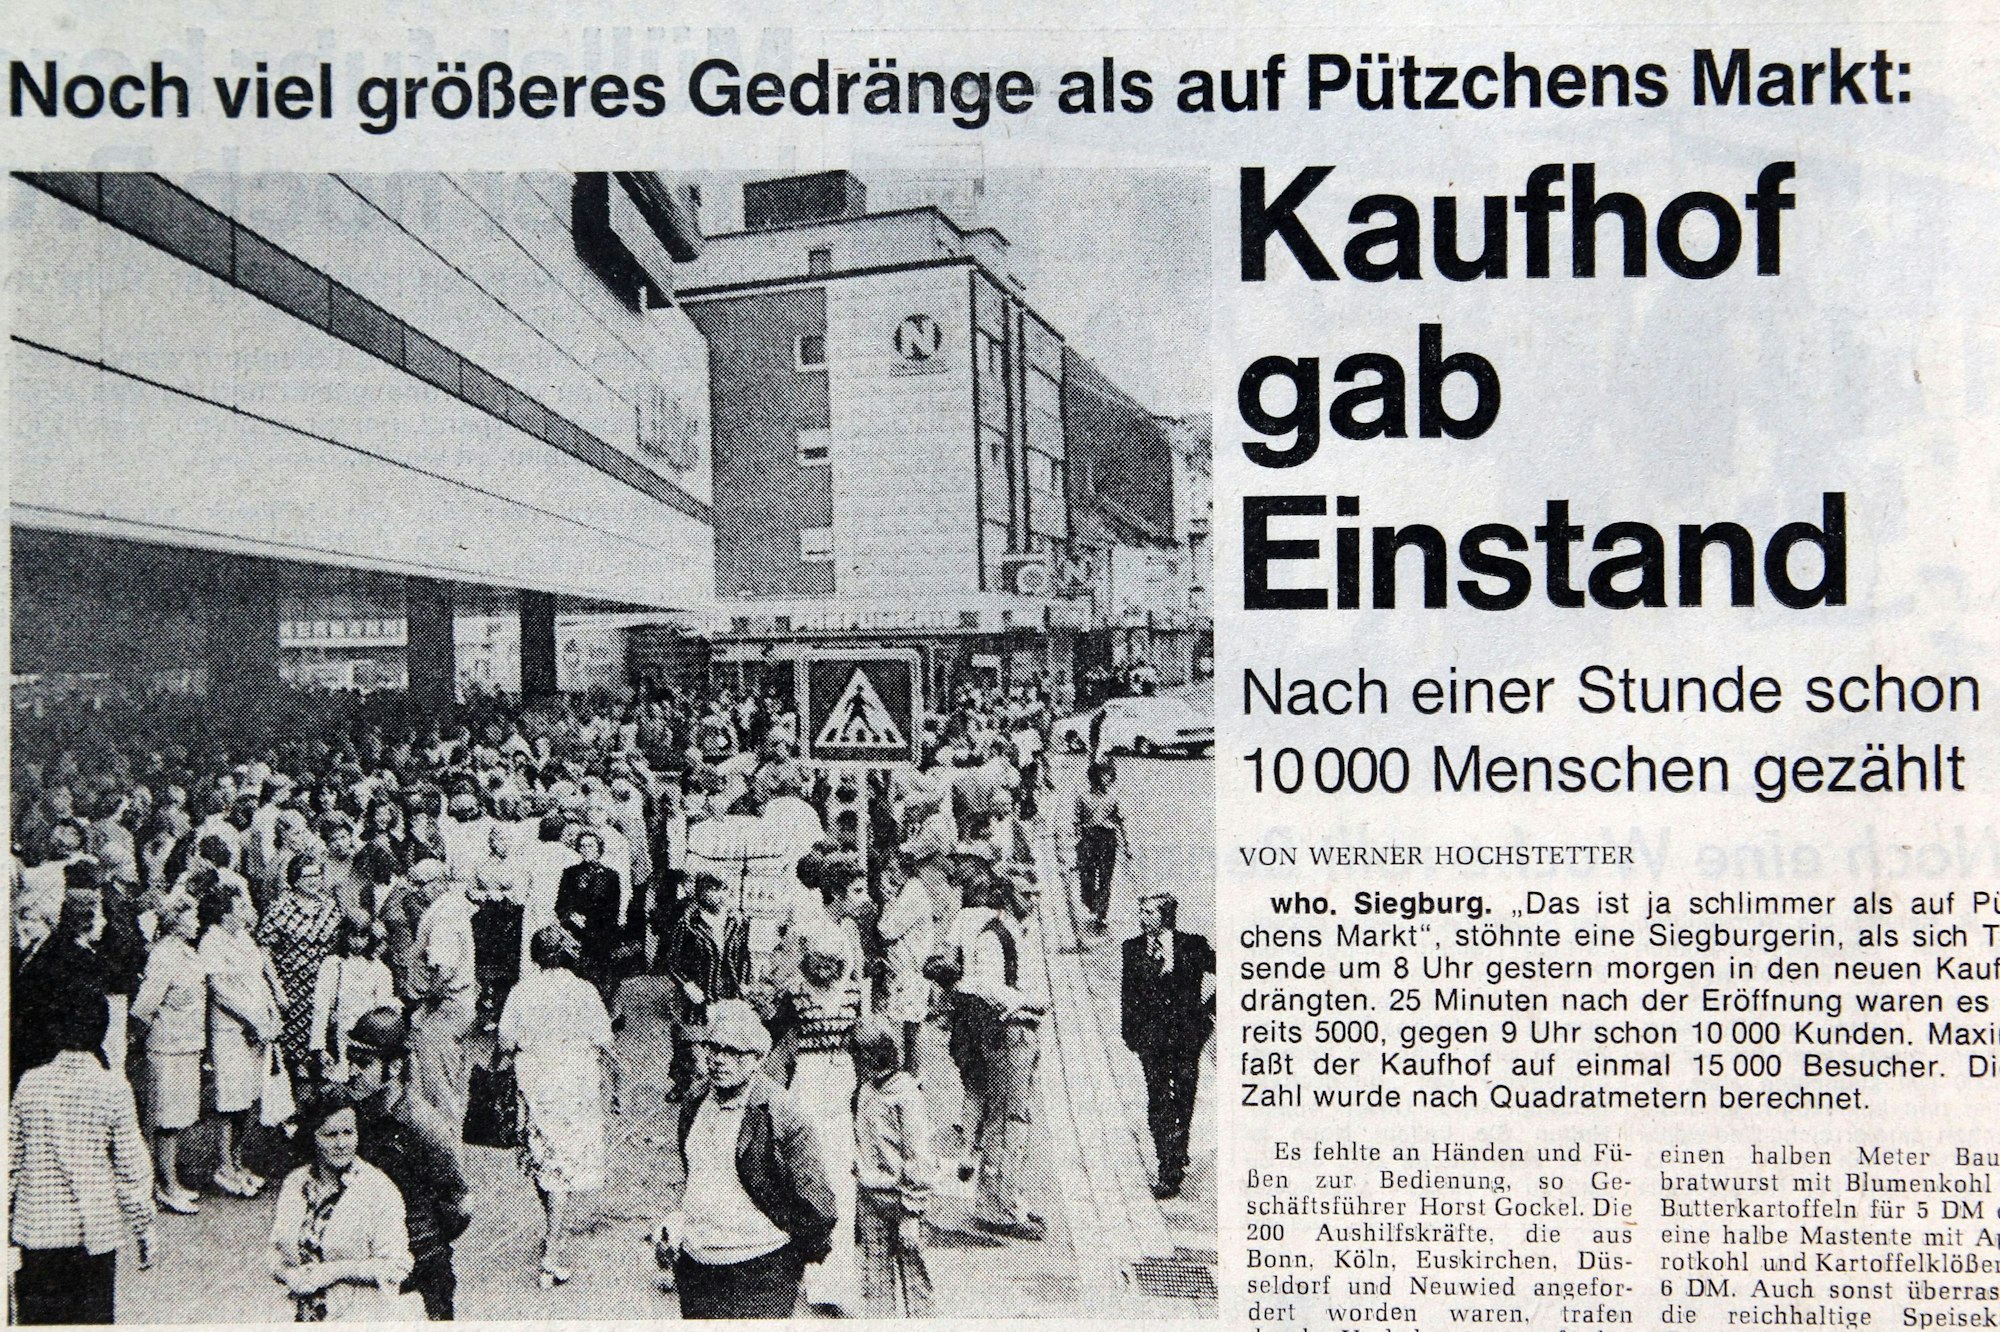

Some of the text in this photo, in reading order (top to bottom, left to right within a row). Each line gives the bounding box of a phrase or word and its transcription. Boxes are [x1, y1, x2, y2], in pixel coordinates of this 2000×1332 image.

[9, 47, 1911, 135] Noch viel größeres Gedränge als auf Pützchens Markt:
[1239, 160, 1796, 283] Kaufhof
[1237, 322, 1502, 470] gab
[1242, 491, 1847, 612] Einstand
[1243, 664, 1979, 716] Nach einer Stunde schon
[1434, 744, 1729, 794] Menschen
[1754, 743, 1966, 804] gezählt
[1239, 845, 1635, 867] VON WERNER HOCHSTETTER
[1269, 891, 1337, 916] who.
[1354, 891, 1492, 920] Siegburg.
[1512, 891, 1580, 918] „Das
[1598, 891, 1629, 915] ist
[1645, 890, 1672, 920] ja
[1689, 891, 1836, 915] schlimmer
[1853, 891, 1893, 915] als
[1911, 891, 1955, 915] auf
[1240, 924, 1322, 949] chens
[1337, 923, 1440, 950] Markt“,
[1455, 923, 1561, 947] stöhnte
[1574, 923, 1635, 947] eine
[1649, 922, 1843, 953] Siegburgerin,
[1858, 923, 1899, 948] als
[1912, 923, 1967, 948] sich
[1240, 956, 1326, 981] sende
[1339, 961, 1380, 980] um
[1393, 956, 1409, 980] 8
[1423, 955, 1474, 980] Uhr
[1486, 957, 1592, 985] gestern
[1607, 961, 1715, 985] morgen
[1730, 955, 1753, 980] in
[1767, 956, 1819, 980] den
[1834, 961, 1921, 980] neuen
[1240, 987, 1989, 1018] drängten. 25 Minuten nach der Eröffnung waren es
[1242, 1019, 1303, 1044] reits
[1315, 1020, 1386, 1047] 5000,
[1400, 1025, 1488, 1050] gegen
[1501, 1020, 1517, 1044] 9
[1531, 1020, 1582, 1044] Uhr
[1594, 1020, 1677, 1045] schon
[1795, 1021, 1913, 1046] Kunden.
[1241, 1051, 1294, 1076] faßt
[1313, 1052, 1361, 1076] der
[1381, 1052, 1492, 1076] Kaufhof
[1511, 1052, 1556, 1077] auf
[1576, 1052, 1670, 1077] einmal
[1804, 1053, 1945, 1079] Besucher.
[1241, 1083, 1869, 1111] Zahl wurde nach Quadratmetern berechnet.
[1274, 1140, 1632, 1163] Es fehlte an Händen und Fü-
[1660, 1144, 1725, 1165] einen
[1750, 1144, 1831, 1166] halben
[1856, 1146, 1931, 1166] Meter
[1247, 1168, 1632, 1194] ßen zur Bedienung, so Ge-
[1660, 1170, 1992, 1194] bratwurst mit Blumenkohl
[1246, 1194, 1632, 1217] schäftsführer Horst Gockel. Die
[1660, 1197, 1857, 1219] Butterkartoffeln
[1870, 1198, 1906, 1219] für
[1916, 1200, 1929, 1219] 5
[1941, 1200, 1984, 1220] DM
[1246, 1222, 1632, 1244] 200 Aushilfskräfte, die aus
[1661, 1224, 1710, 1245] eine
[1722, 1224, 1788, 1245] halbe
[1800, 1225, 1912, 1246] Mastente
[1924, 1226, 1963, 1247] mit
[1246, 1248, 1633, 1271] Bonn, Köln, Euskirchen, Düs-
[1660, 1250, 1749, 1272] rotkohl
[1762, 1251, 1808, 1272] und
[1247, 1274, 1633, 1300] seldorf und Neuwied angefor-
[1660, 1279, 1673, 1297] 6
[1687, 1278, 1736, 1298] DM.
[1750, 1277, 1814, 1299] Auch
[1829, 1282, 1893, 1300] sonst
[1248, 1300, 1633, 1324] dert worden waren, trafen
[1661, 1303, 1697, 1324] die
[1727, 1304, 1872, 1330] reichhaltige
